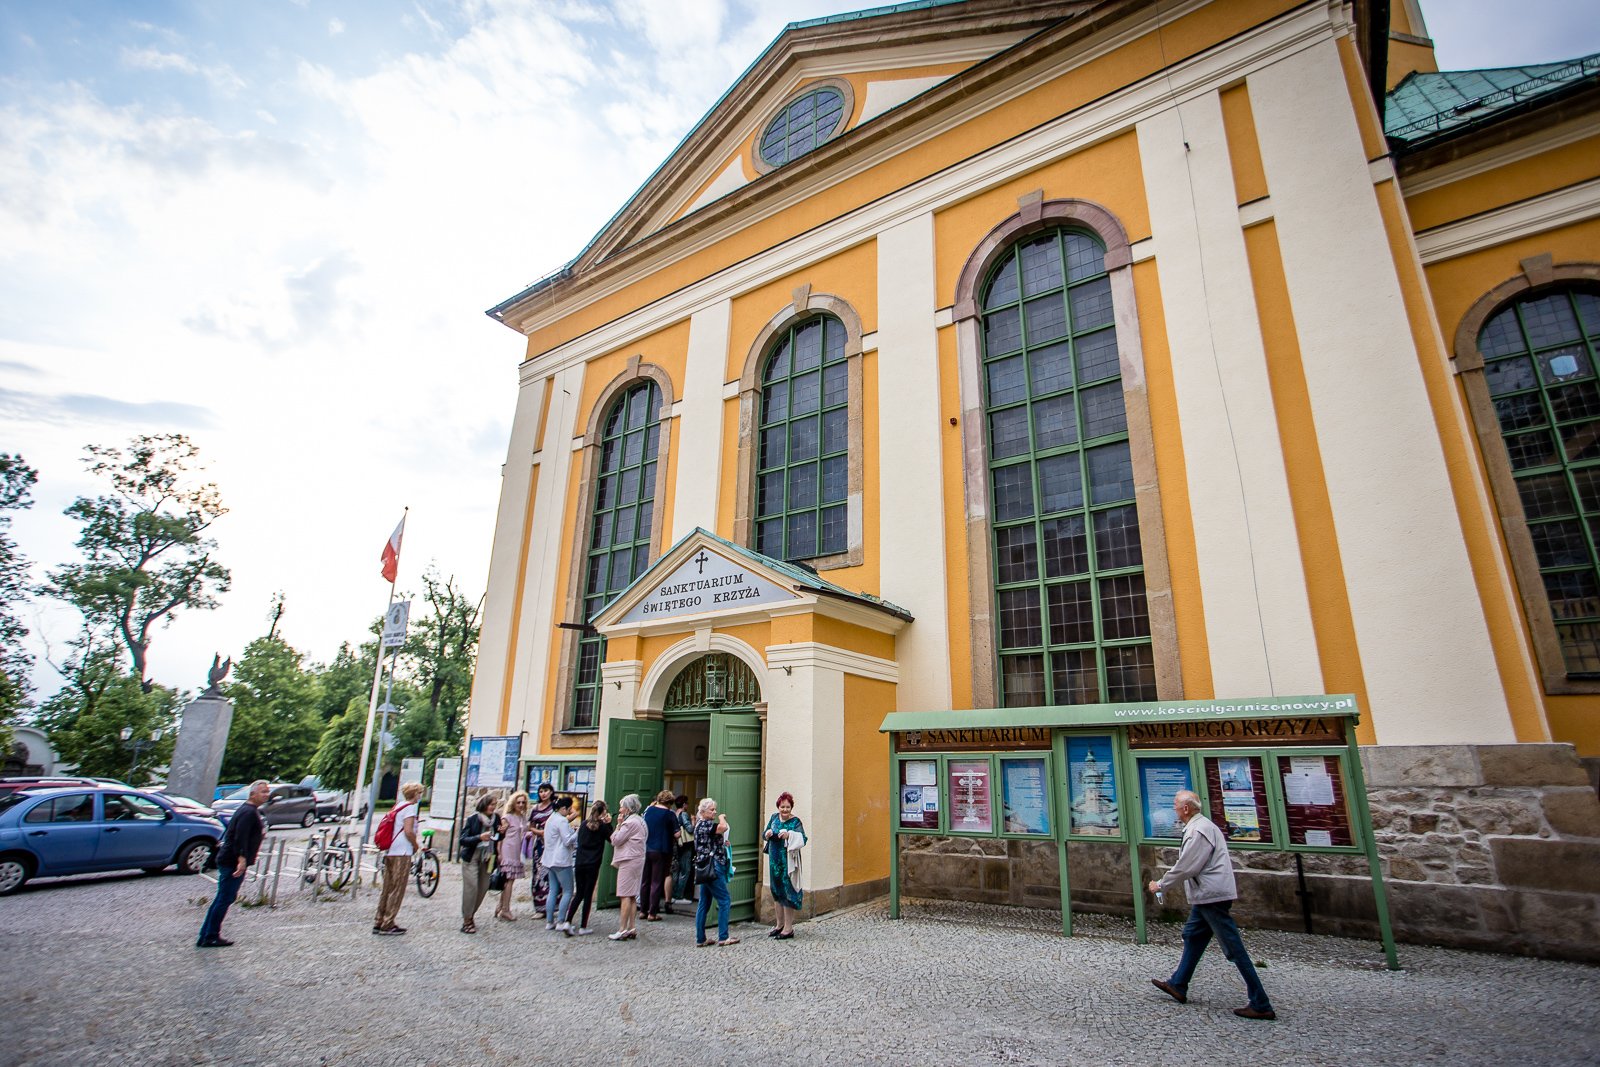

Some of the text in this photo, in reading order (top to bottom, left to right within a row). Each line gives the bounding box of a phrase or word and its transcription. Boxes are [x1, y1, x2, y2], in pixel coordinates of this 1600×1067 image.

[660, 573, 744, 597] SANKTUARIUM
[643, 586, 761, 614] ŚWIĘTEGO KRZYŻA
[927, 727, 1045, 744] SANKTUARIUM
